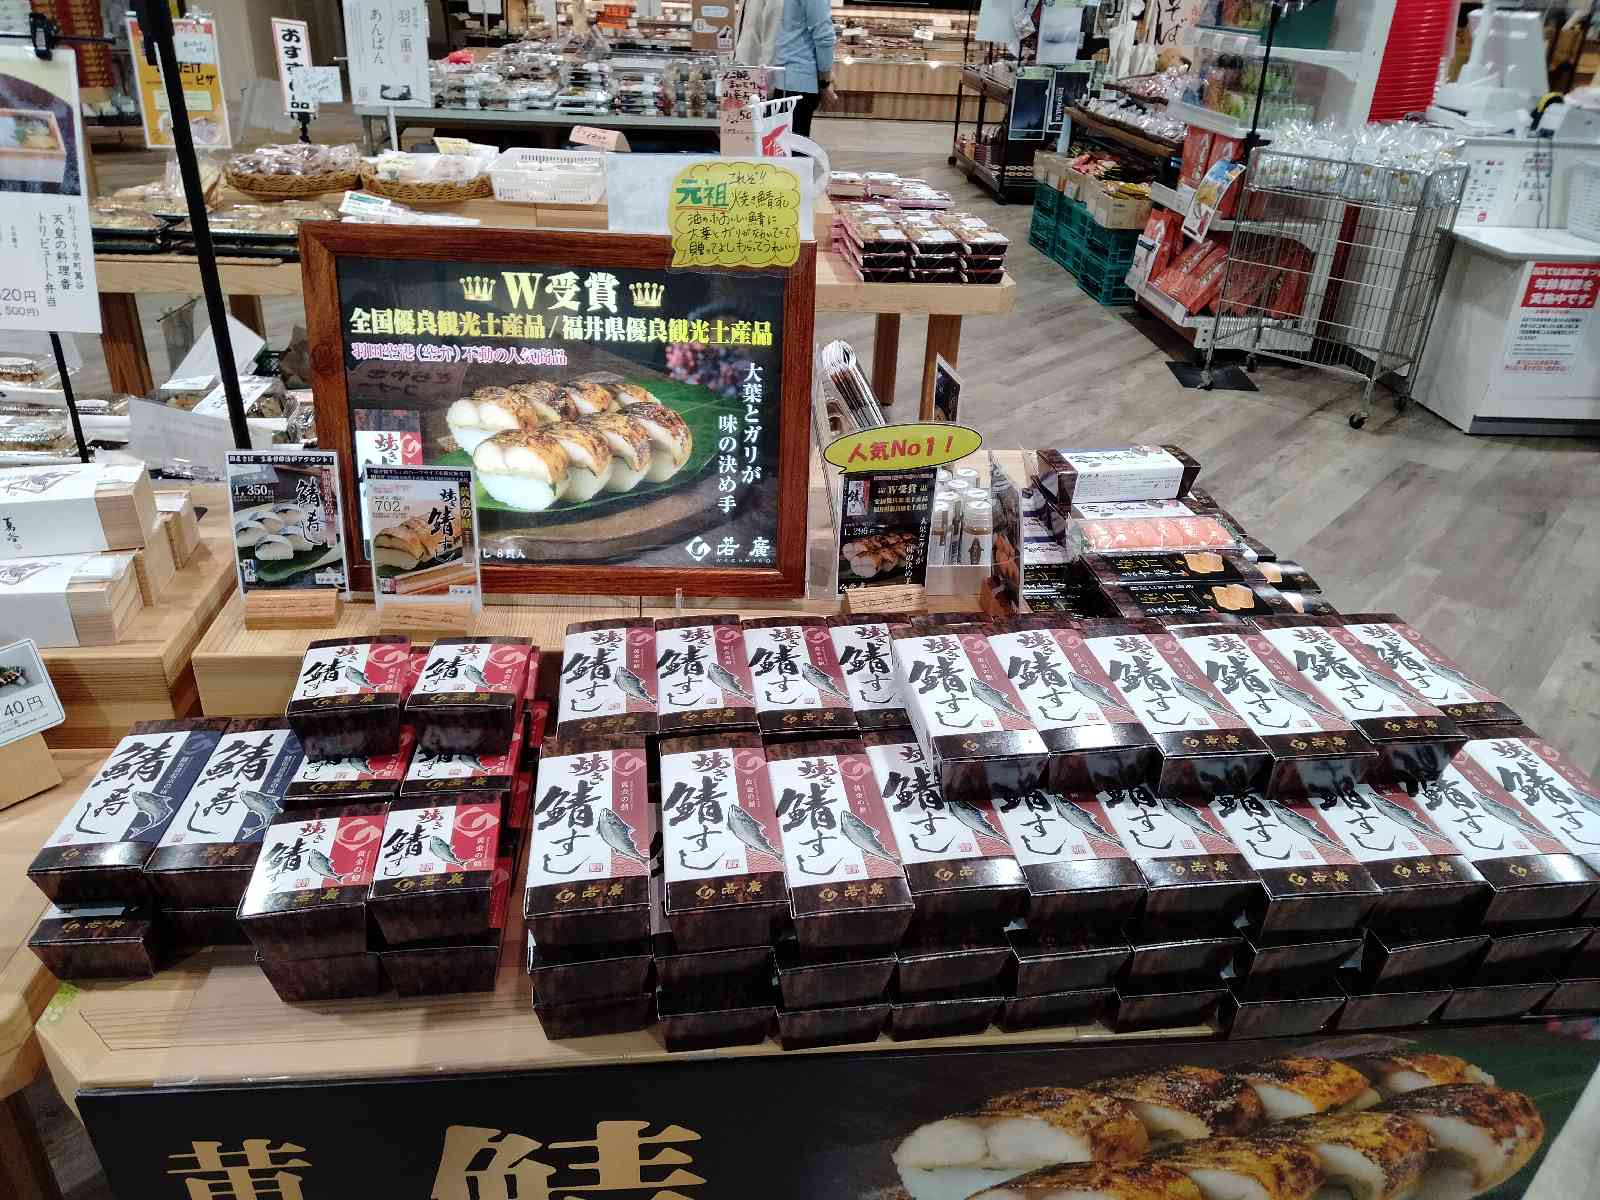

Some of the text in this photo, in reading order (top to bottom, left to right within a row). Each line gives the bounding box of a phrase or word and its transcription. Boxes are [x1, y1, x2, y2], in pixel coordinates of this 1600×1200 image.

[717, 415, 738, 513] 味の決め手
[743, 362, 763, 485] 大葉とガリが
[535, 753, 610, 875] 焼き鯖すし
[663, 751, 731, 871] 焼き鯖すし
[776, 758, 844, 876] 焼き鯖すし
